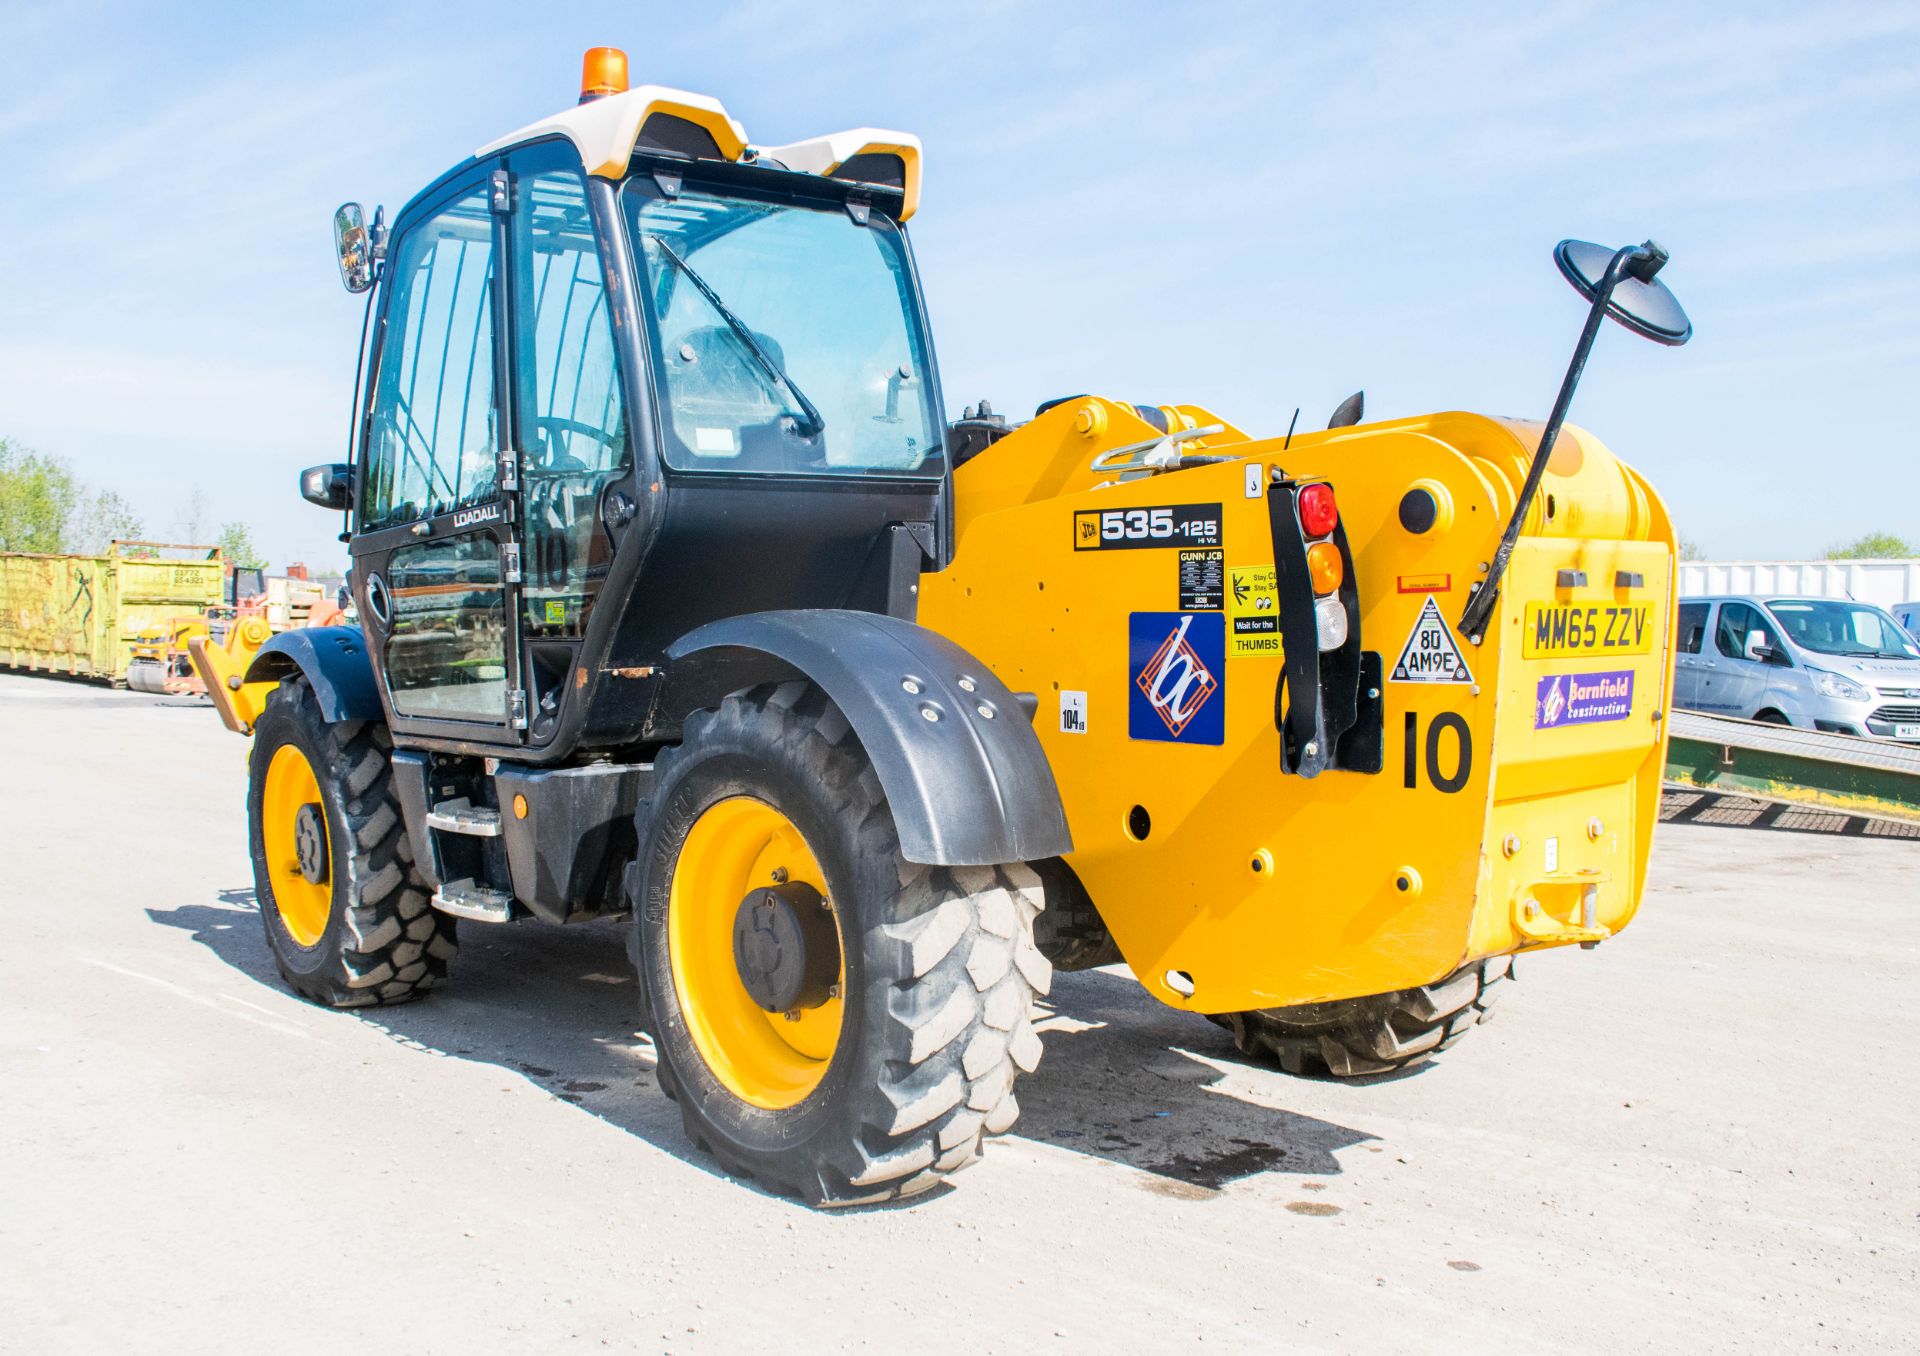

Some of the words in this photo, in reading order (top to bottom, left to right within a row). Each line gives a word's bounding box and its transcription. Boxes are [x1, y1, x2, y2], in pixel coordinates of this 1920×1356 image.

[453, 505, 500, 528] LOADALL
[1081, 522, 1097, 539] JCB
[1180, 552, 1205, 561] GUNN
[1206, 551, 1223, 560] JCB
[1253, 574, 1267, 582] Stay
[1253, 584, 1267, 592] Stay
[1235, 621, 1250, 630] Wait
[1251, 620, 1261, 629] for
[1262, 620, 1274, 629] the
[1535, 608, 1599, 650] MM65
[1602, 607, 1647, 647] ZZV
[1235, 638, 1279, 651] THUMBS
[1409, 652, 1455, 672] AM9E
[1569, 676, 1630, 701] Barnfield
[1567, 702, 1627, 719] construction
[1062, 709, 1078, 730] 104
[1403, 711, 1473, 794] 10
